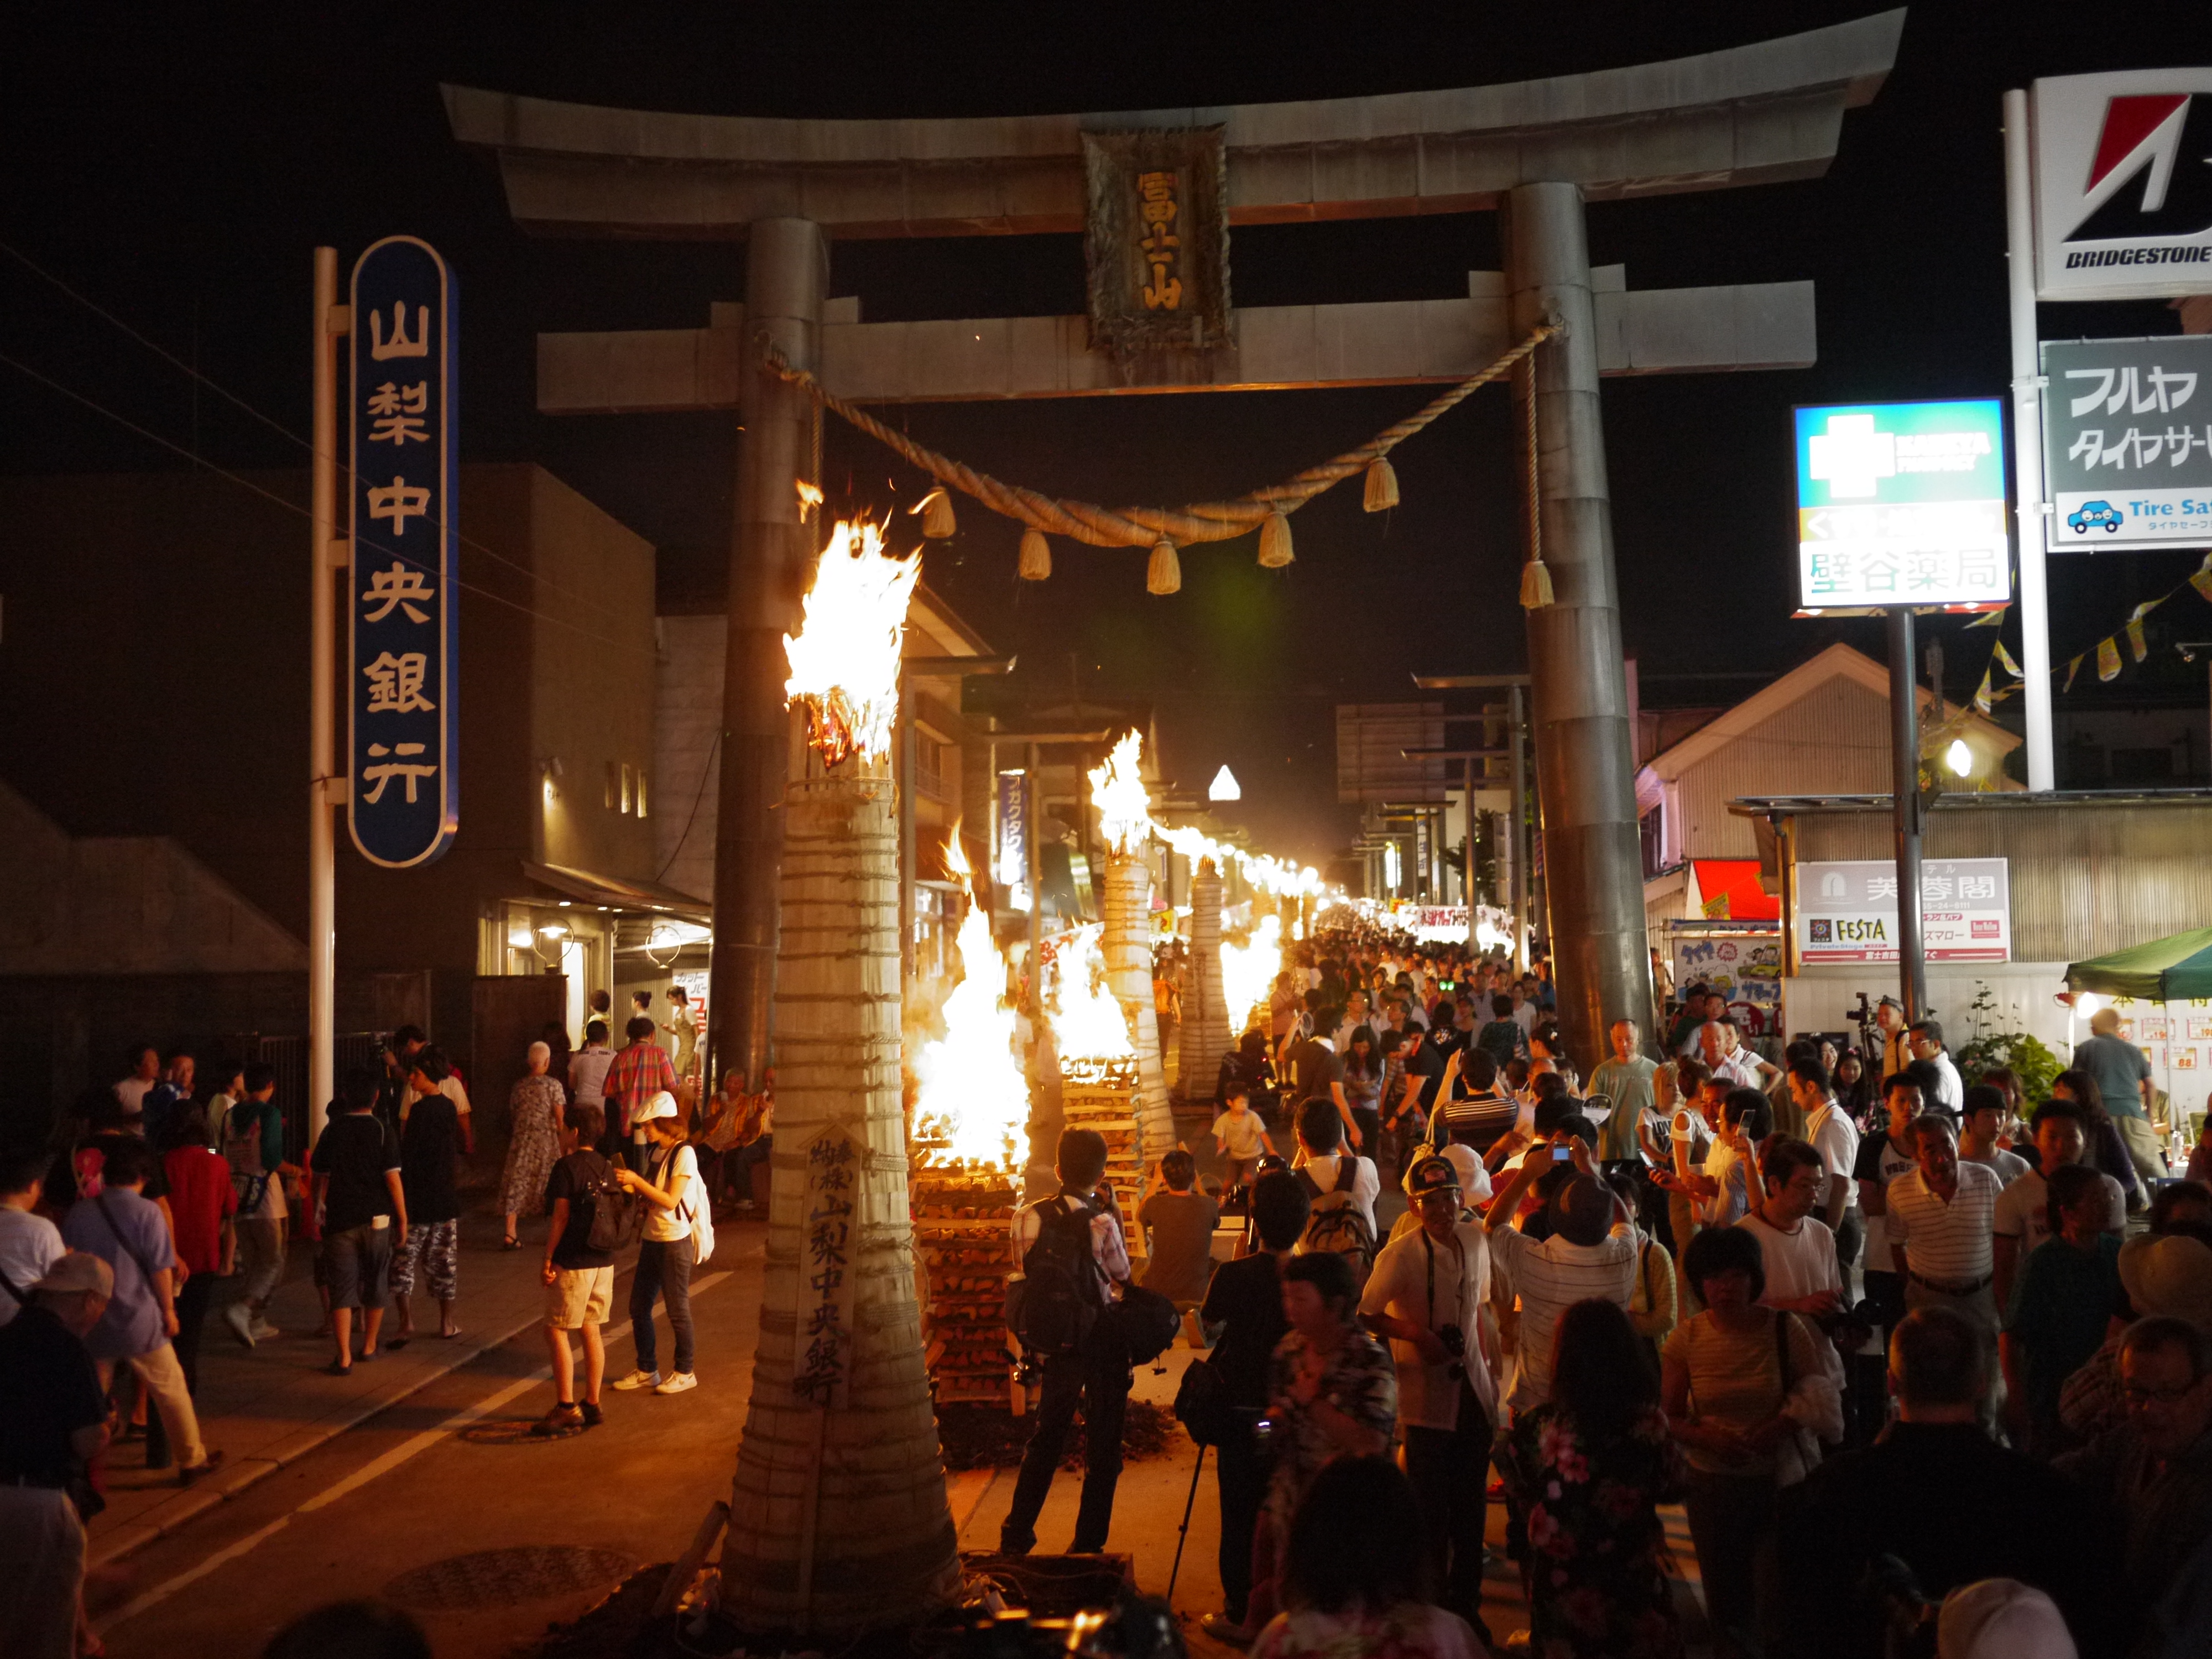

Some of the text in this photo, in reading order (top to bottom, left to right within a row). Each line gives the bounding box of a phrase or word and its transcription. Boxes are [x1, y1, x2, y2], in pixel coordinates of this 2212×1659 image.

[2065, 246, 2212, 269] BRIDGESTONE
[2065, 366, 2198, 418] フルヤ
[2129, 499, 2212, 516] Tire Sa
[362, 300, 437, 804] 山梨中央銀行
[1811, 549, 1997, 593] 壁谷薬局
[1927, 864, 1956, 874] テル
[1837, 919, 1886, 941] FESTA
[1925, 931, 1964, 940] ズマロー
[2178, 1058, 2192, 1067] 88
